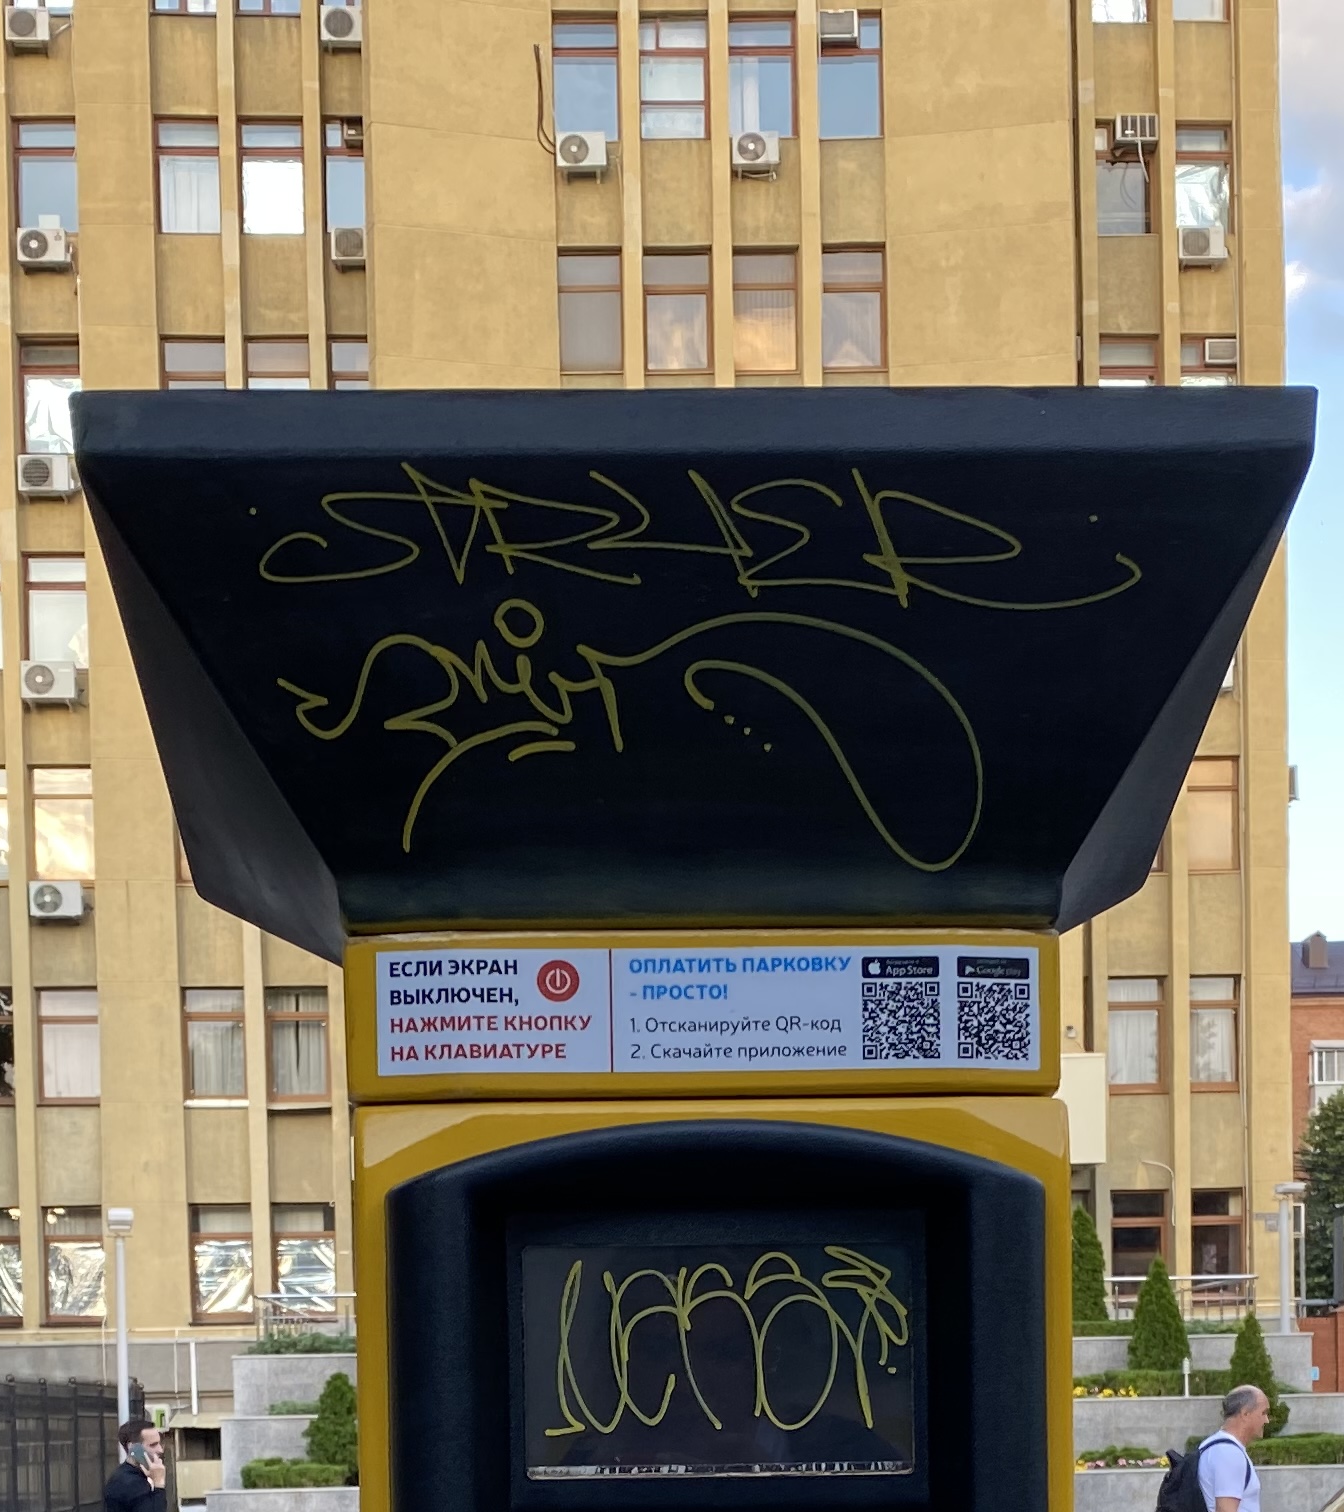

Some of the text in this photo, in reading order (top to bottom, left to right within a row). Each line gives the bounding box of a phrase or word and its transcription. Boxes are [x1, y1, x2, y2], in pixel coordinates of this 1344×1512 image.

[389, 959, 518, 977] ЕСЛИ ЭКРАН
[629, 956, 851, 974] ОПЛАТИТЬ ПАРКОВКУ
[389, 987, 519, 1006] ВЫКЛЮЧЕН,
[642, 984, 728, 1000] ПРОСТО!
[390, 1015, 592, 1033] НАЖМИТЕ КНОПКУ
[630, 1016, 842, 1036] 1. Отсканируйте QR-код
[391, 1043, 566, 1062] НА КЛАВИАТУРЕ
[630, 1043, 847, 1062] 2. Скачайте приложение
